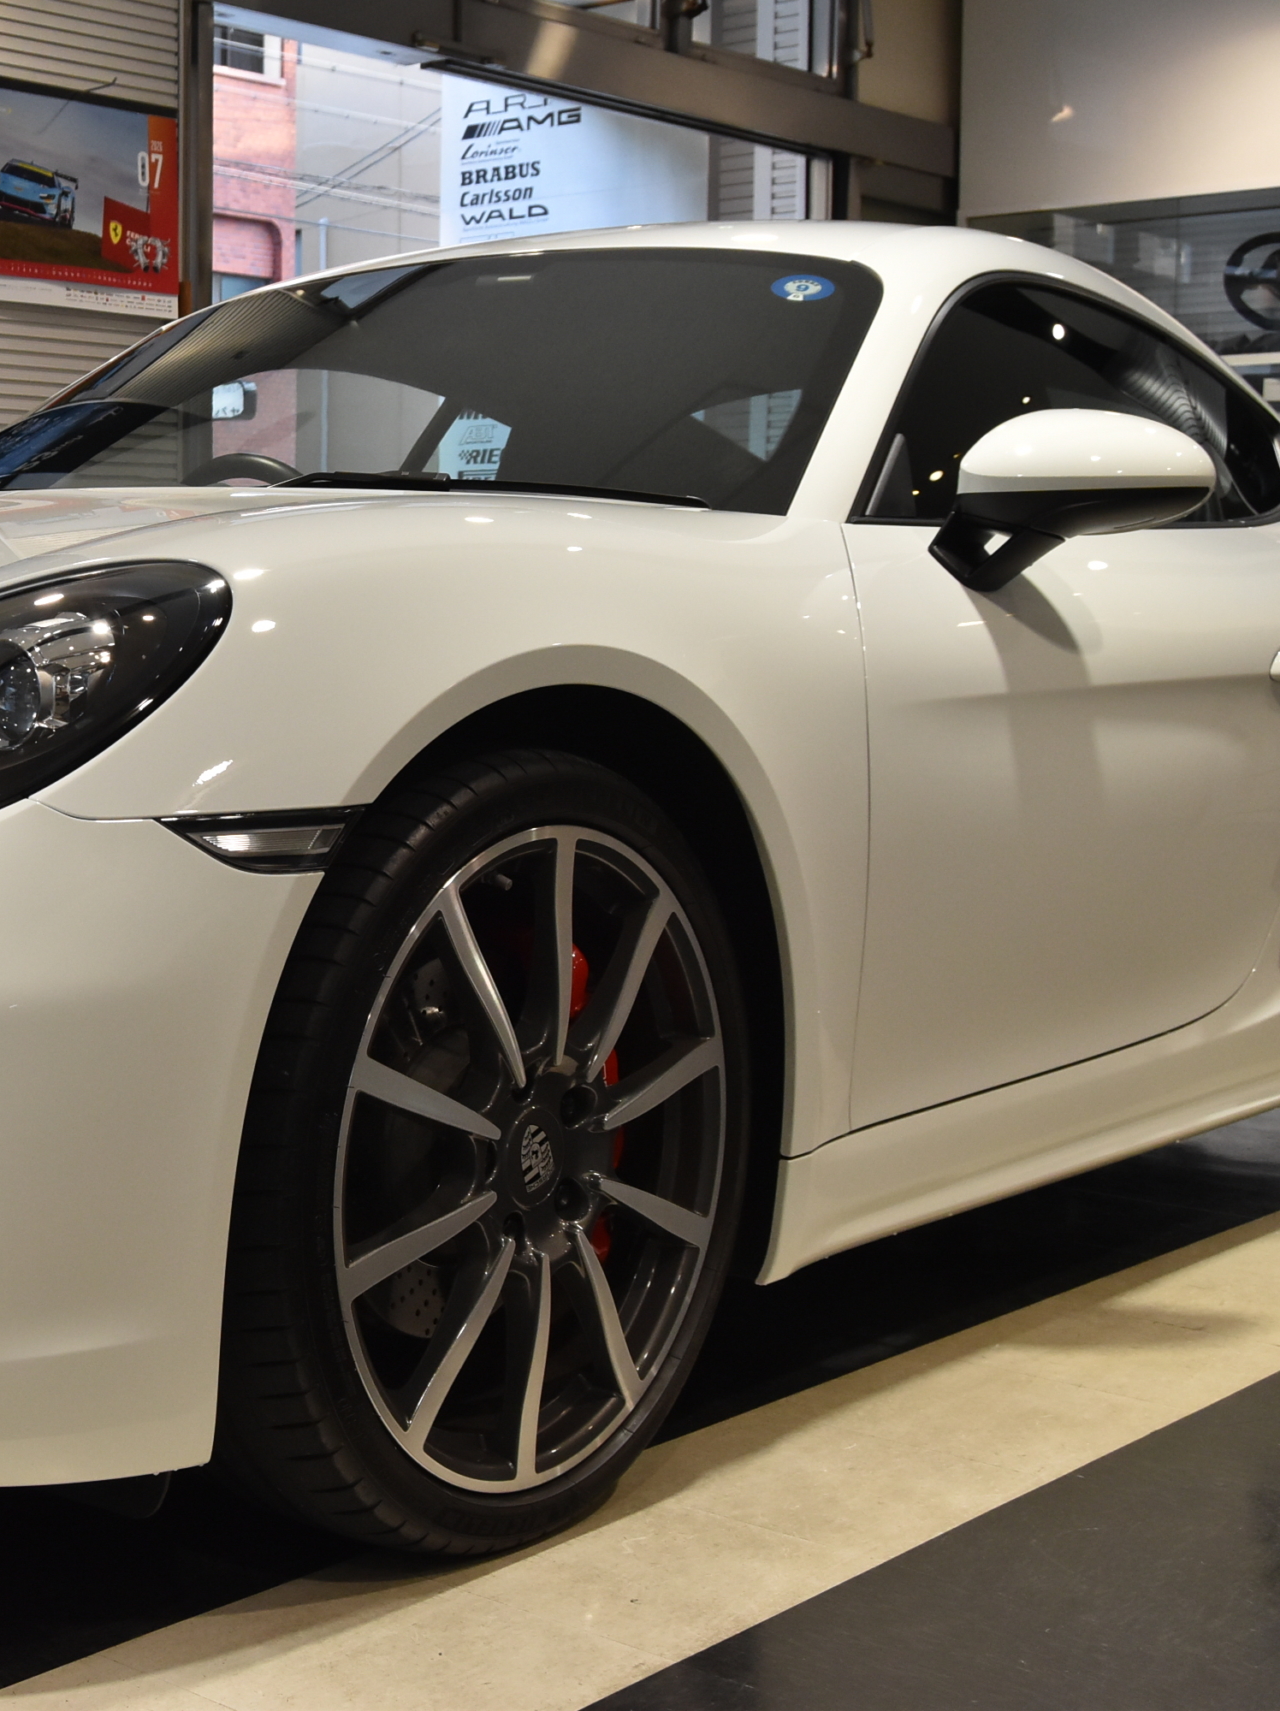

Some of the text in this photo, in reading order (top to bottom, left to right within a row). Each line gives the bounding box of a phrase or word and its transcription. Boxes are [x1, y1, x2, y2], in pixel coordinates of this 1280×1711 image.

[498, 106, 582, 135] AMG
[137, 150, 164, 189] 07
[460, 160, 541, 186] BRABUS
[460, 186, 534, 207] Carlsson
[461, 204, 549, 226] WALD
